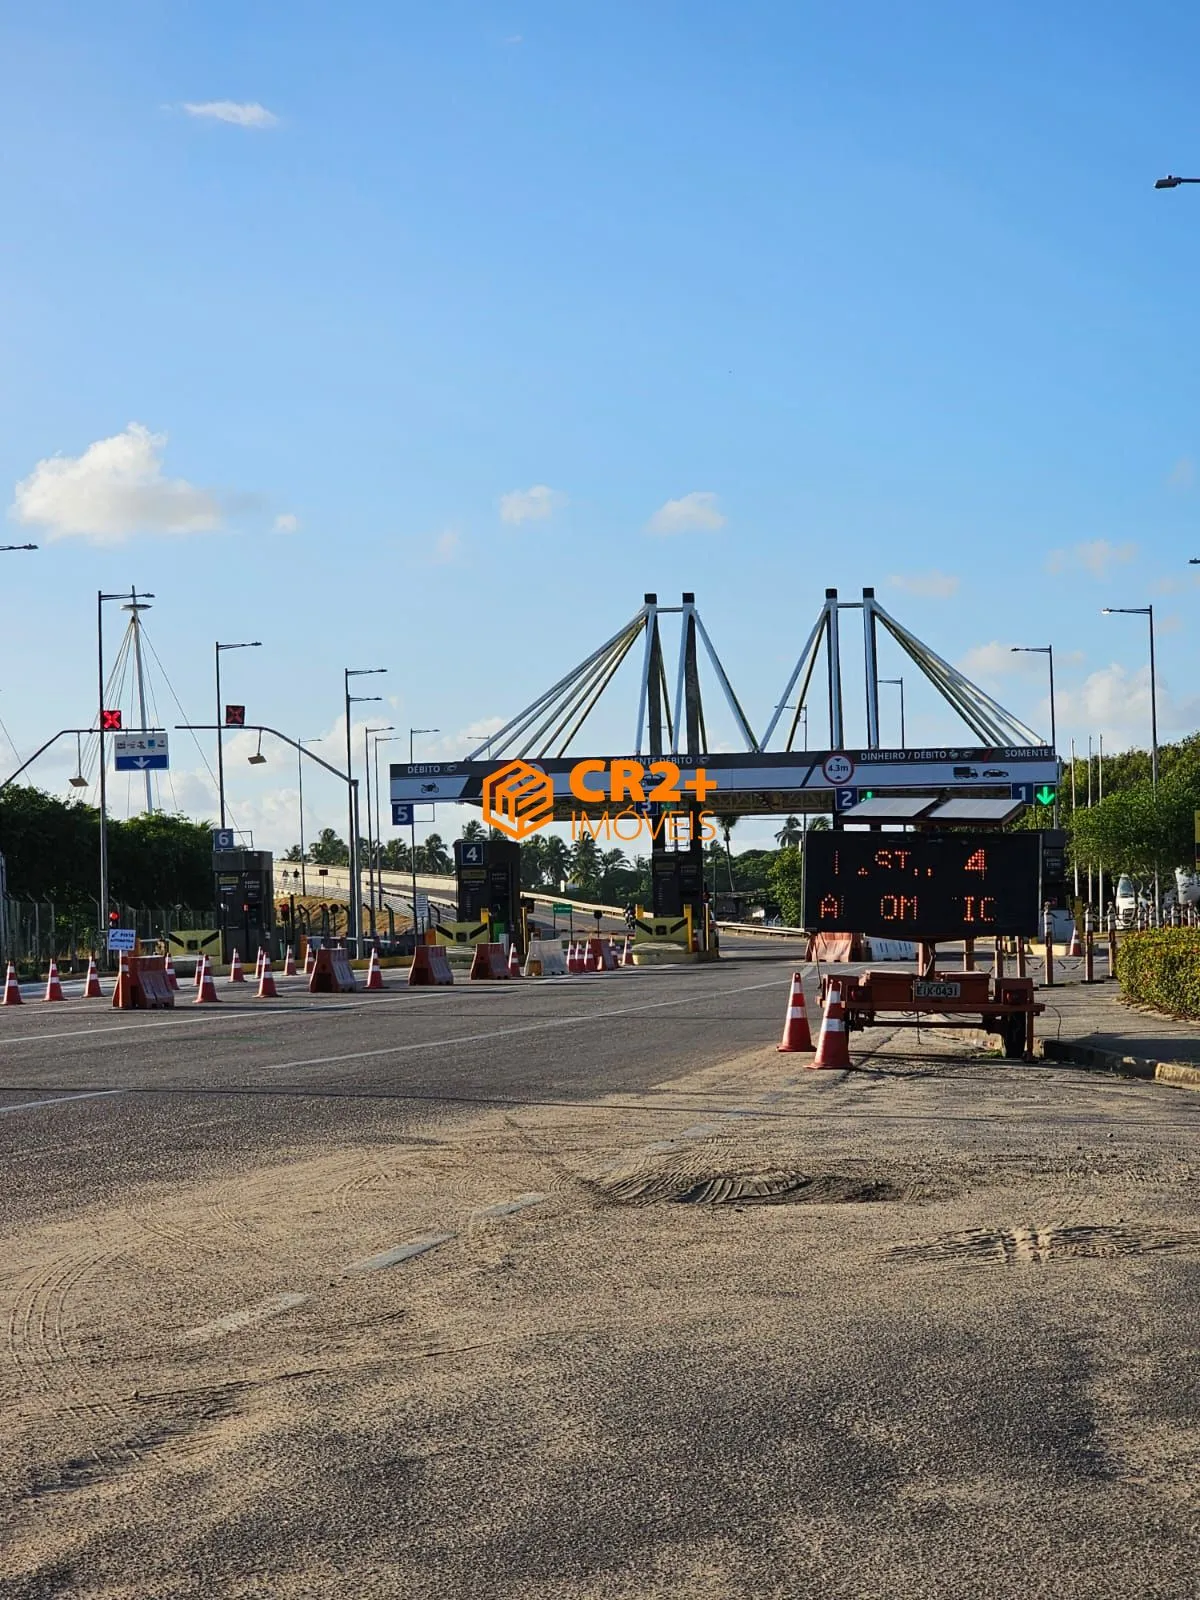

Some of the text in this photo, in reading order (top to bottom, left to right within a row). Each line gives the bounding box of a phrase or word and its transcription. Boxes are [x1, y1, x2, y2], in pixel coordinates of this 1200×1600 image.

[860, 752, 905, 761] DINHEIRO
[914, 749, 947, 760] DÉBITO
[1004, 748, 1049, 757] SOMENTE
[407, 765, 440, 774] DÉBITO
[827, 764, 849, 772] 4.3m
[841, 790, 853, 806] 2
[1018, 786, 1027, 802] 1
[397, 806, 408, 822] 5
[218, 832, 230, 846] 6
[466, 846, 478, 861] 4
